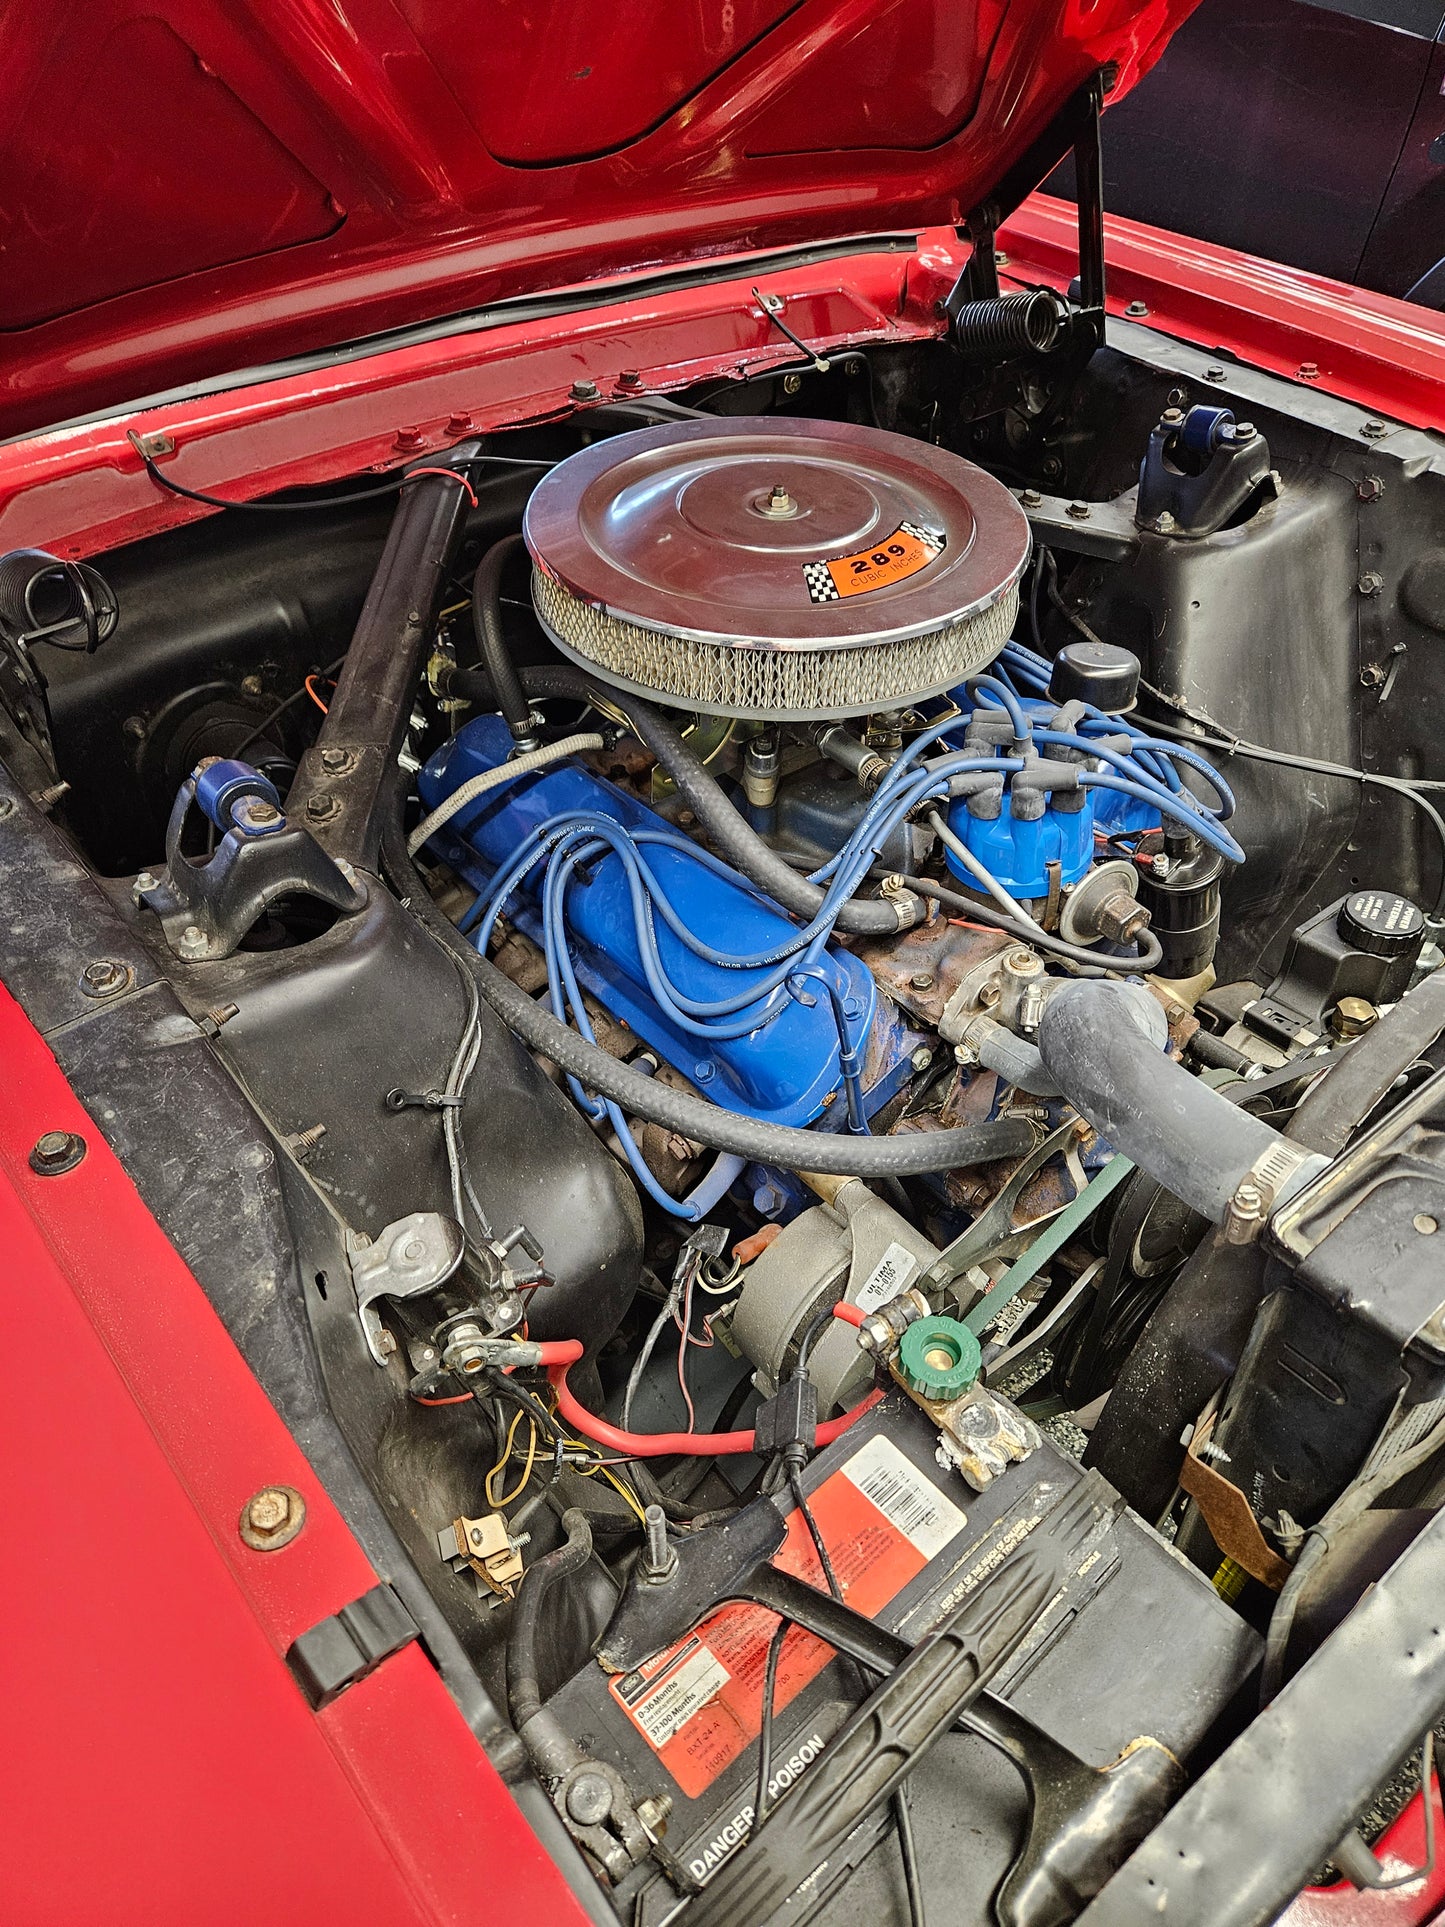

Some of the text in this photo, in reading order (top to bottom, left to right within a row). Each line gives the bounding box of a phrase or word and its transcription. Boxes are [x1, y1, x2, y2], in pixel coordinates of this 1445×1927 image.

[850, 544, 906, 574] 289
[850, 549, 923, 587] CUBIC INCHES
[519, 848, 547, 879] HI-ENERGY
[717, 960, 742, 969] TAYLOR
[764, 939, 805, 964] HI-ENERGY
[806, 896, 849, 941] SUPPRESSION
[848, 870, 866, 894] CABLE
[1384, 899, 1405, 930] STEERING
[1398, 906, 1416, 930] POWER
[866, 1260, 892, 1294] ULTIMA
[874, 1267, 896, 1296] 01-0155
[989, 1553, 1004, 1568] CAPS
[1025, 1514, 1041, 1530] LEVEL
[939, 1518, 1027, 1609] KEEP OUT OF THE REACH OF CHILDREN
[1075, 1550, 1101, 1577] RECYCLE
[637, 1680, 678, 1718] 0-36 Months
[650, 1692, 696, 1736] 37-100 Months
[655, 1721, 679, 1743] Customer
[705, 1680, 721, 1695] charge
[767, 1733, 826, 1799] POISON
[689, 1805, 756, 1881] DANGER
